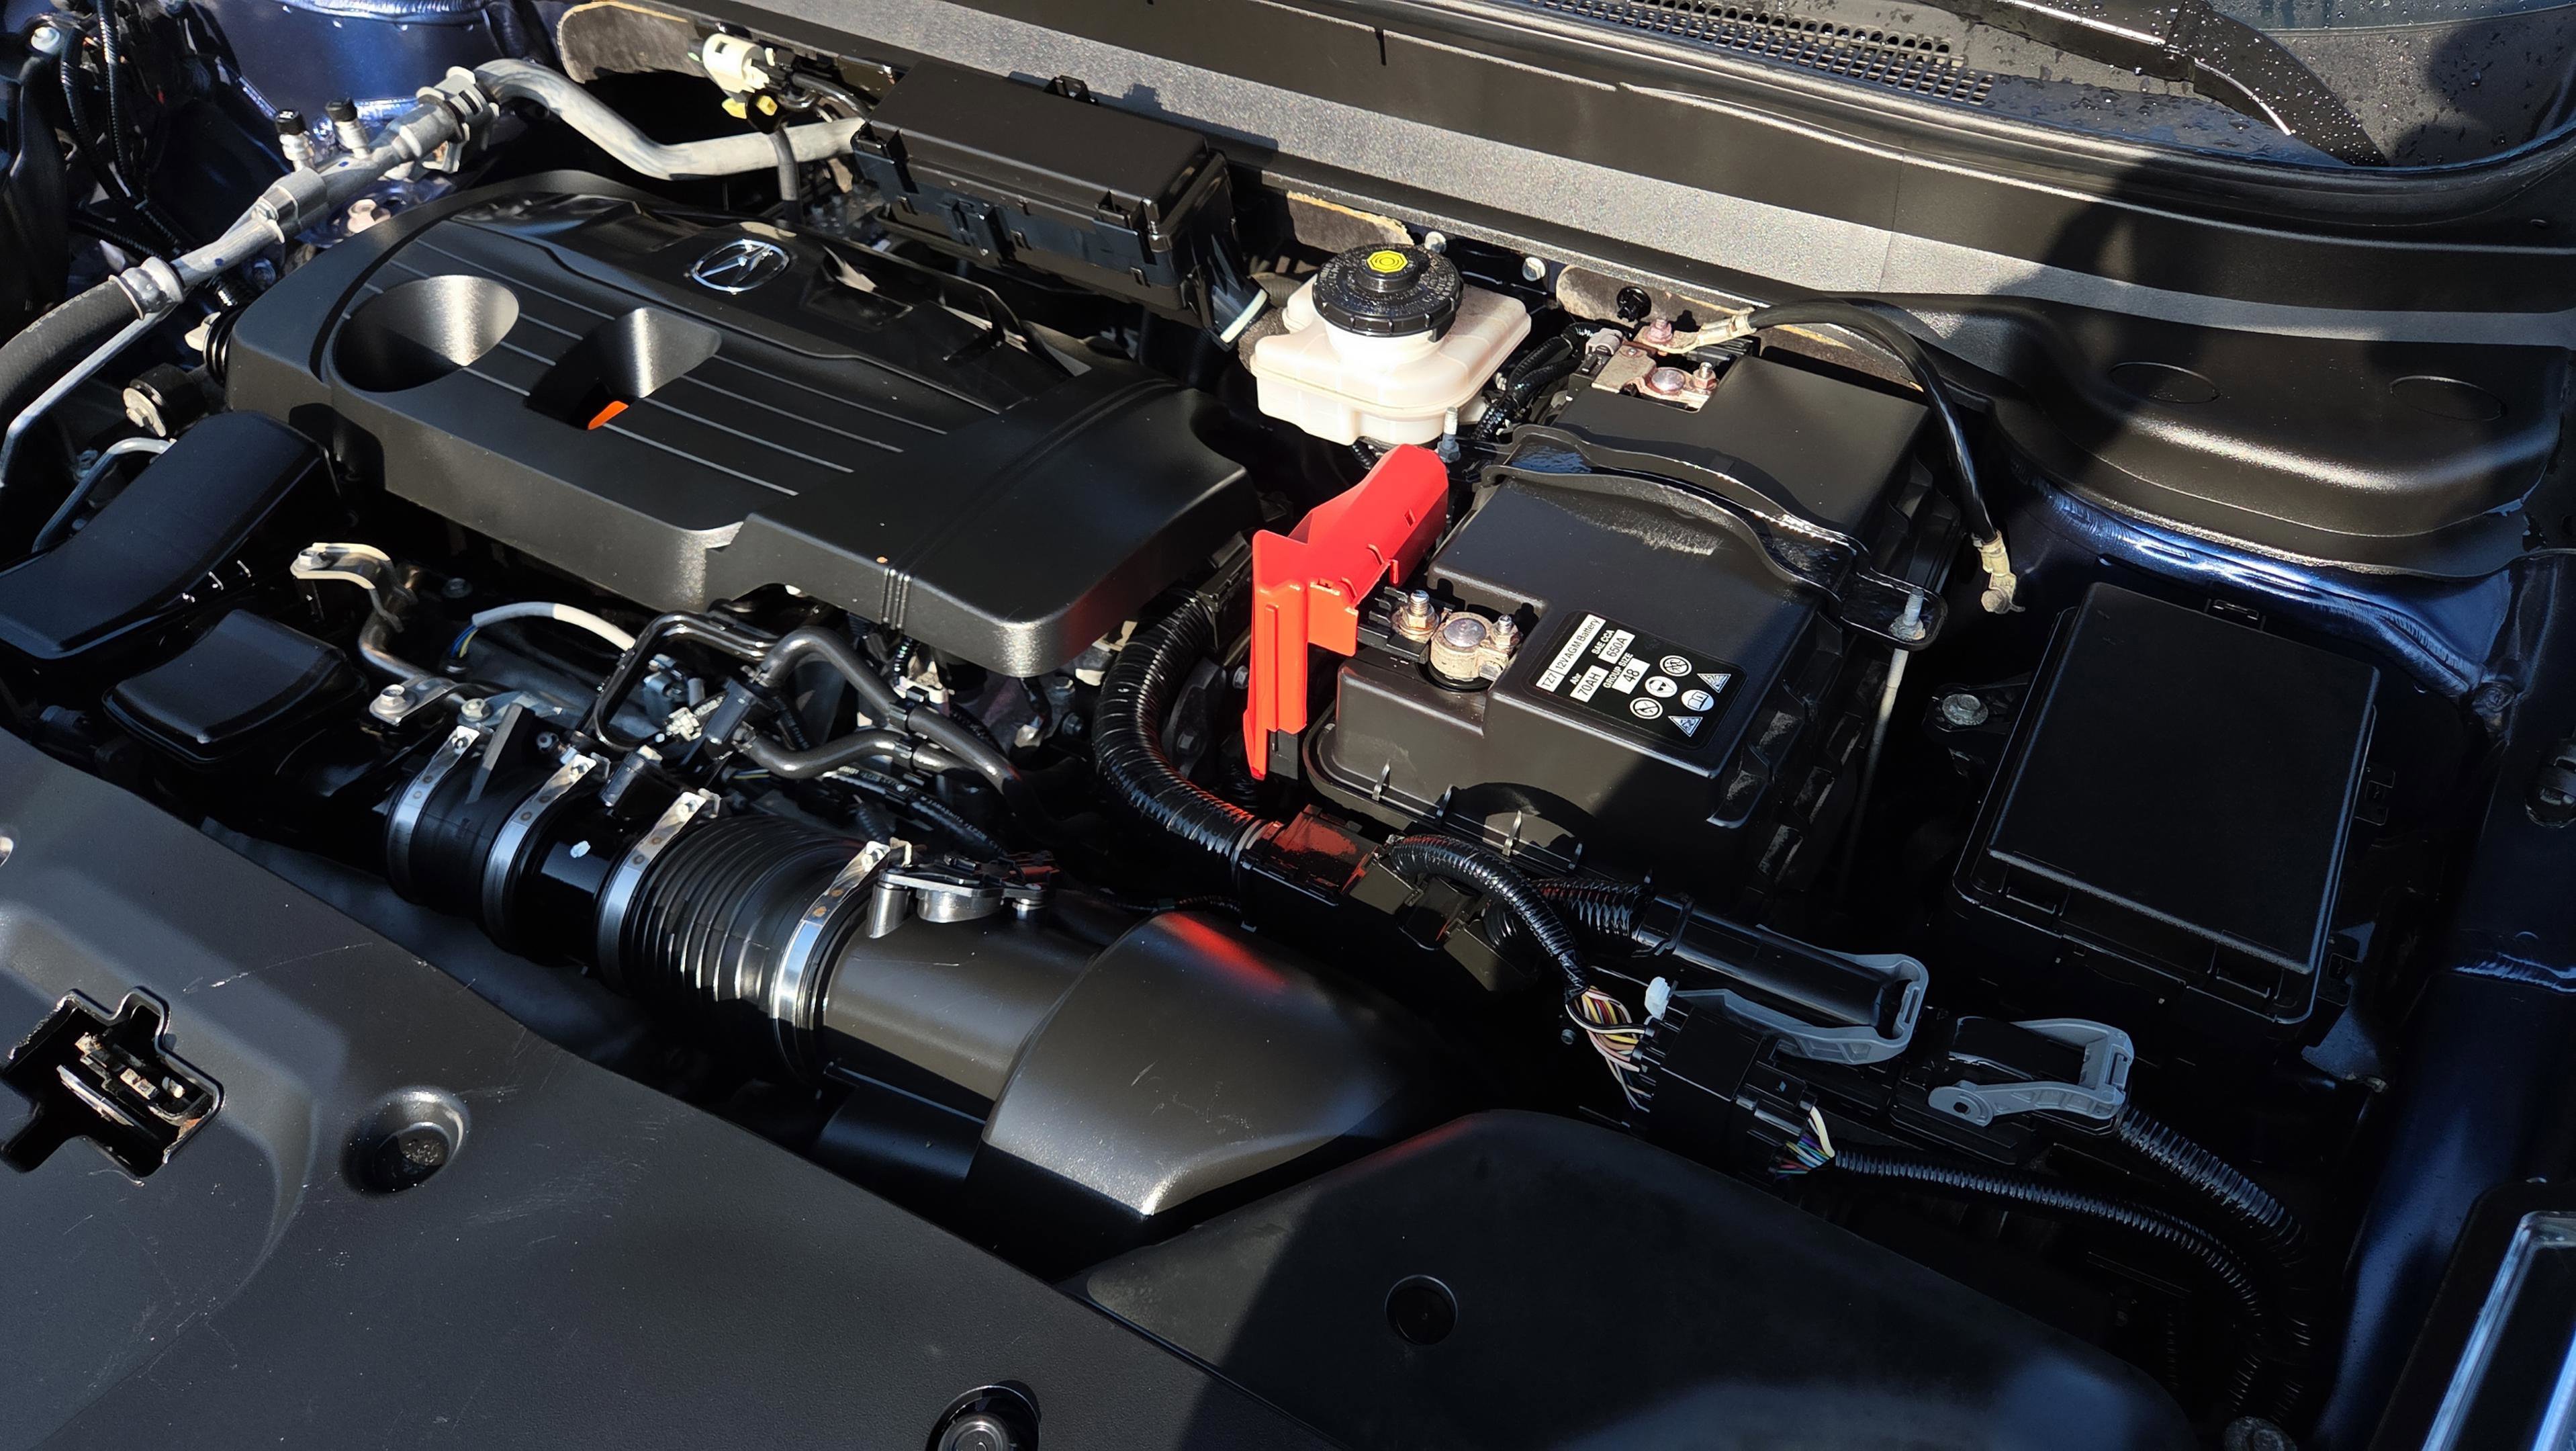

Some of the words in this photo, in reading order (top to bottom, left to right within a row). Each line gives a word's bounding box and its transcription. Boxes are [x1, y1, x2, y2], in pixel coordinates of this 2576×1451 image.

[1541, 672, 1557, 687] TZ7
[1556, 656, 1569, 670] 12V
[1564, 641, 1583, 659] AGM
[1576, 619, 1600, 642] Battery
[1591, 642, 1606, 655] SAE
[1600, 629, 1615, 643] CCA
[1606, 637, 1628, 657] 650A
[1569, 672, 1582, 685] Ahr
[1603, 666, 1622, 688] GROUP
[1618, 652, 1634, 667] SIZE
[1623, 669, 1640, 683] 48
[1577, 672, 1601, 695] 70AH
